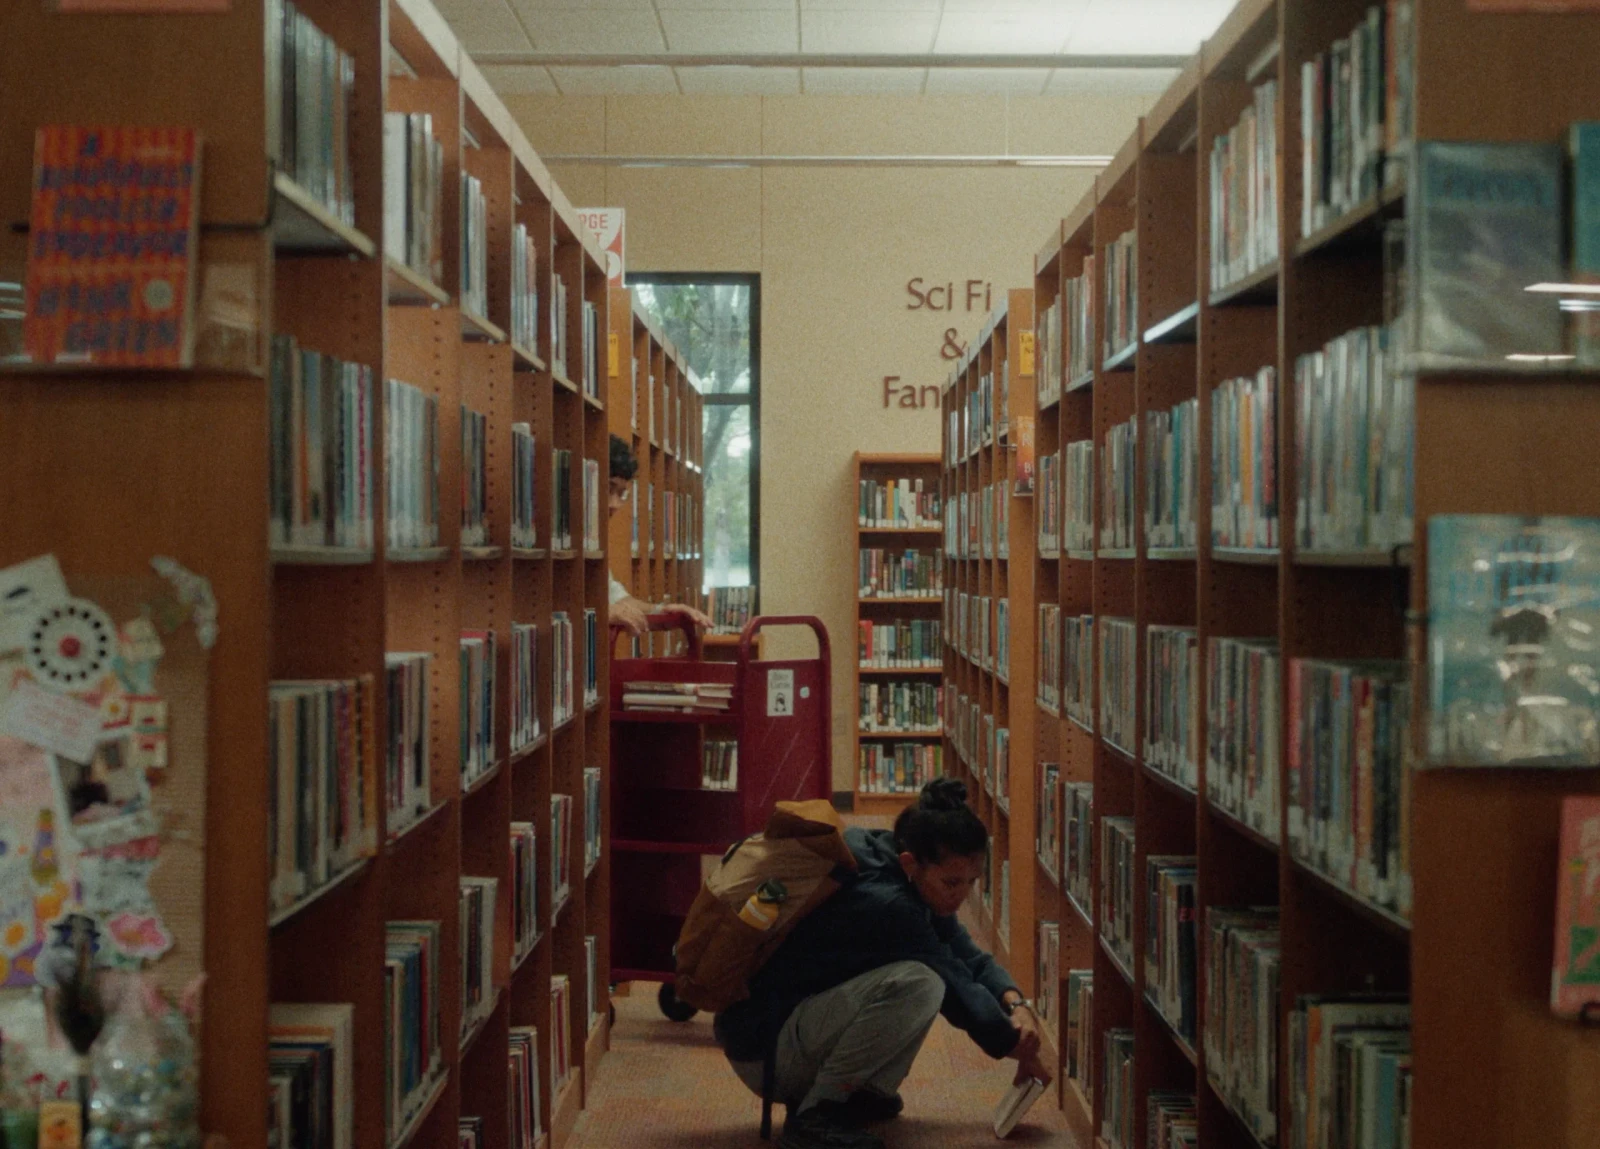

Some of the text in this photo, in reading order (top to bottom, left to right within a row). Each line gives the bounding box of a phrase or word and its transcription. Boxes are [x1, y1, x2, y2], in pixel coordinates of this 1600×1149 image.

[53, 195, 177, 223] FOOLISH
[35, 229, 189, 259] ENDEAVOR
[906, 277, 992, 312] Sci Fi
[940, 327, 968, 361] &
[882, 375, 940, 409] Fan
